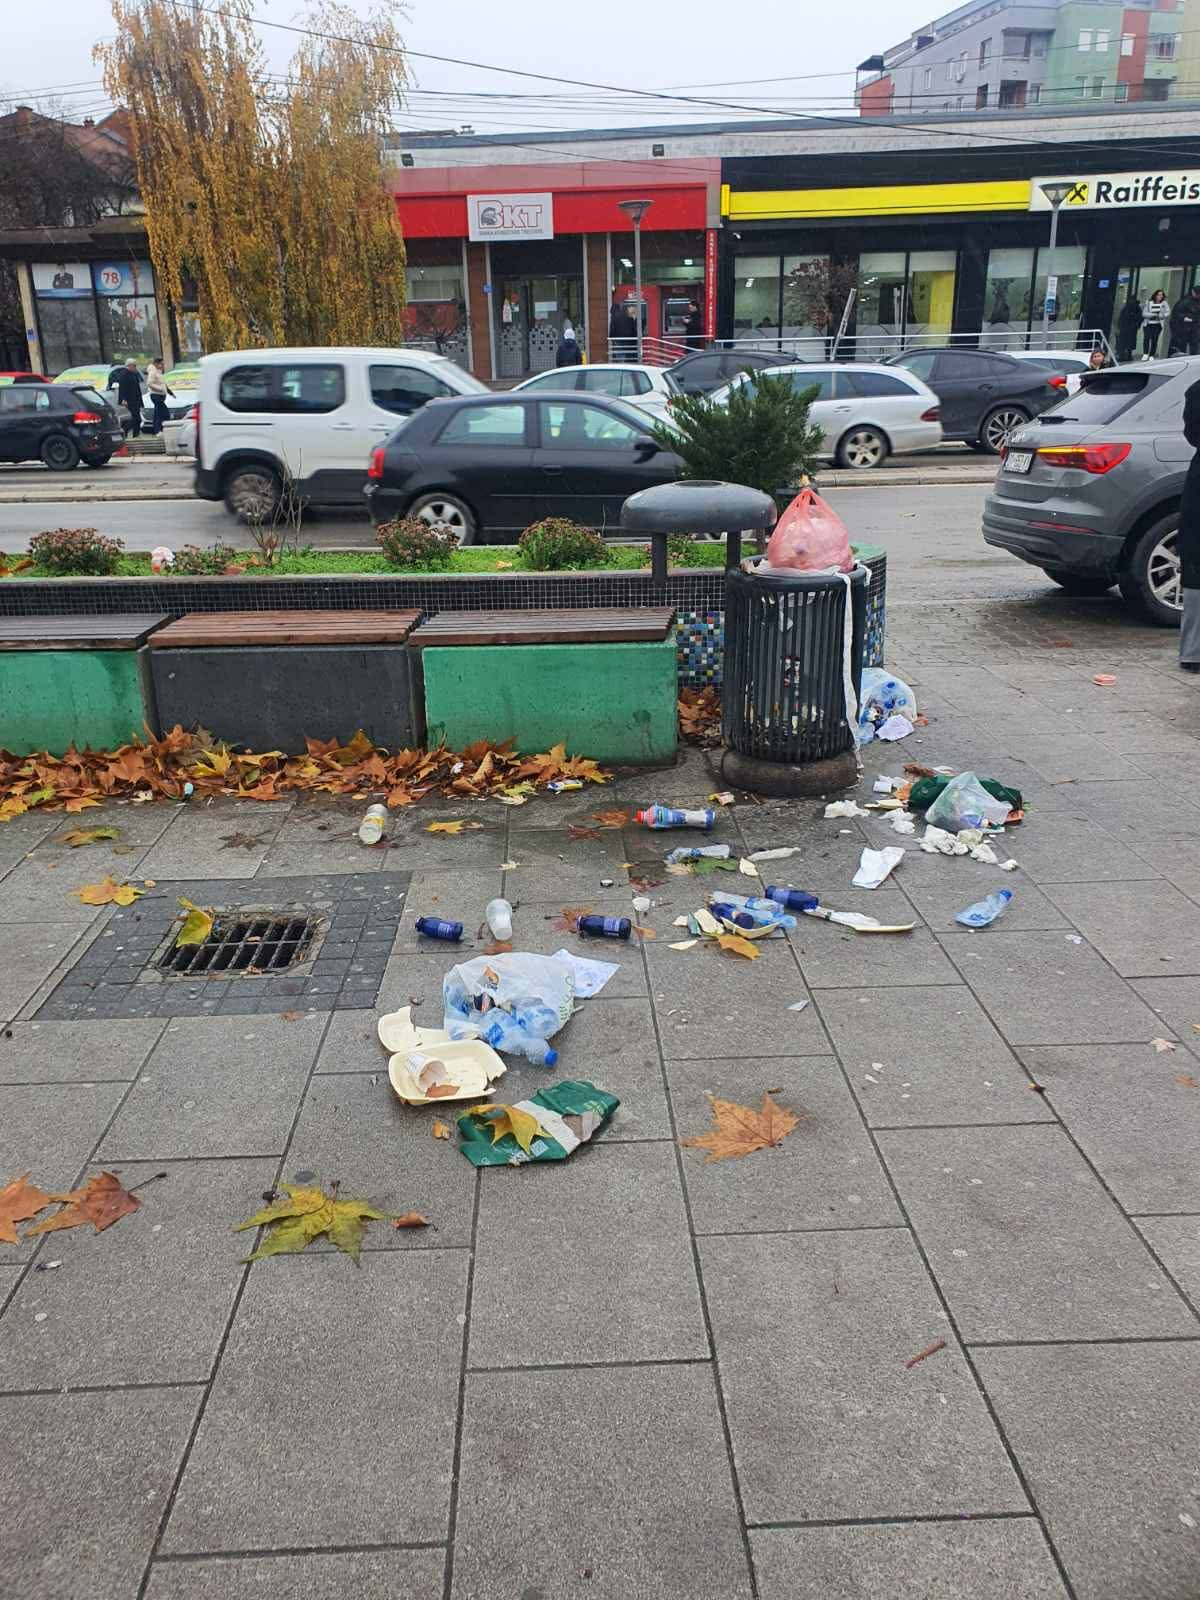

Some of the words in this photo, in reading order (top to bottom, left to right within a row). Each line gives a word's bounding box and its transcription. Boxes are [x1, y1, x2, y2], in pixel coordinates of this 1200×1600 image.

[1095, 176, 1200, 203] Raiffeis
[478, 200, 543, 229] BKT
[103, 272, 119, 284] 78
